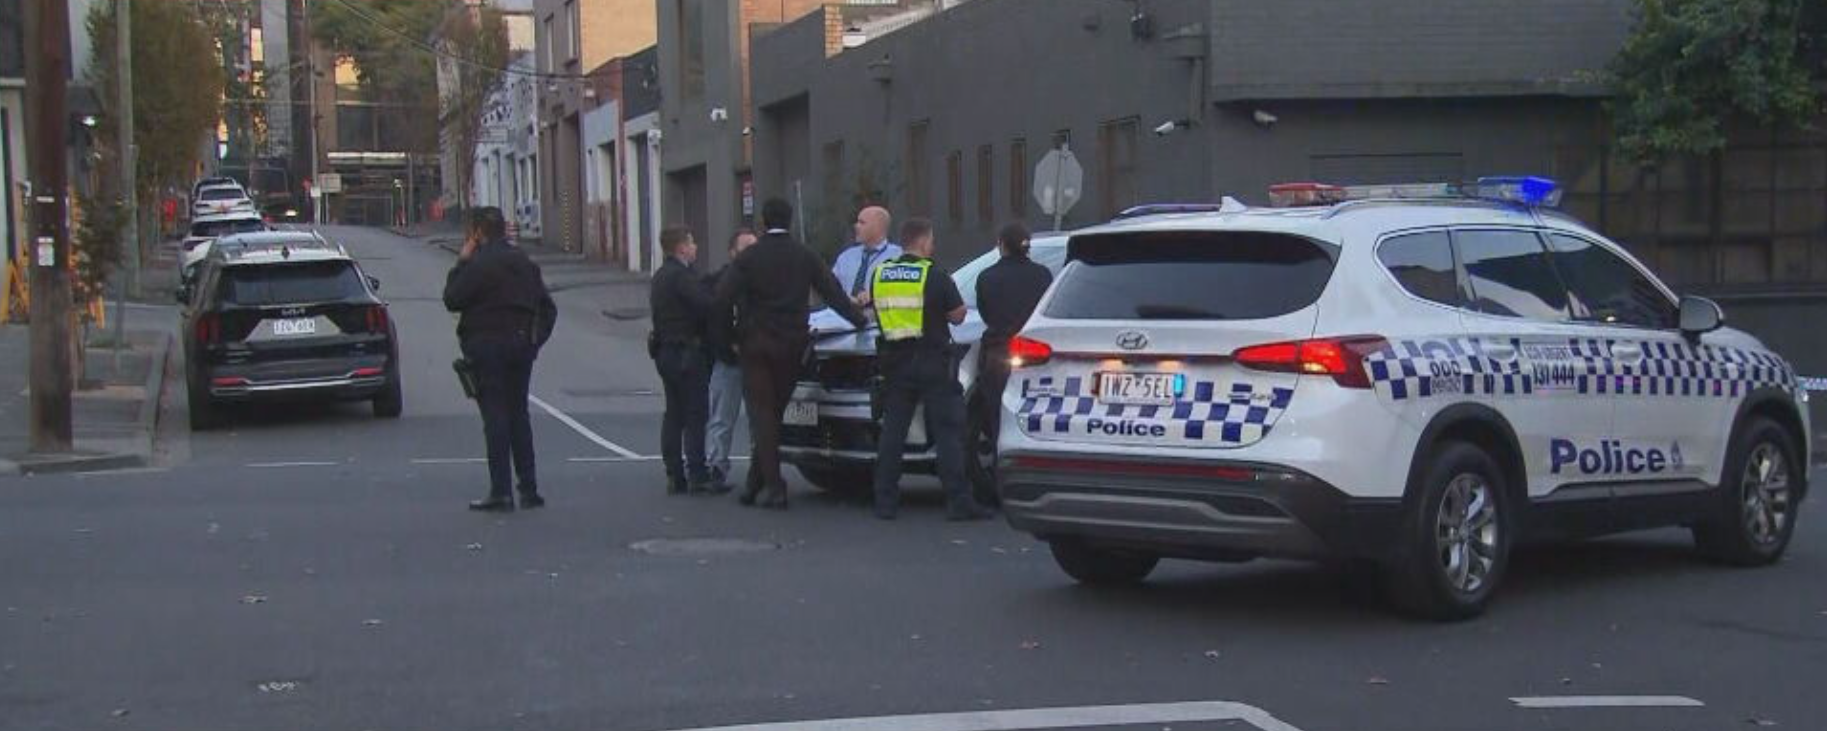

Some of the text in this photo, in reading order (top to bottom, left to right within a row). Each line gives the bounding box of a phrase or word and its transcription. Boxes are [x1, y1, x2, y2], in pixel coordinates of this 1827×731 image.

[881, 266, 920, 280] Police
[1087, 418, 1166, 437] Police
[1550, 438, 1665, 475] Police
